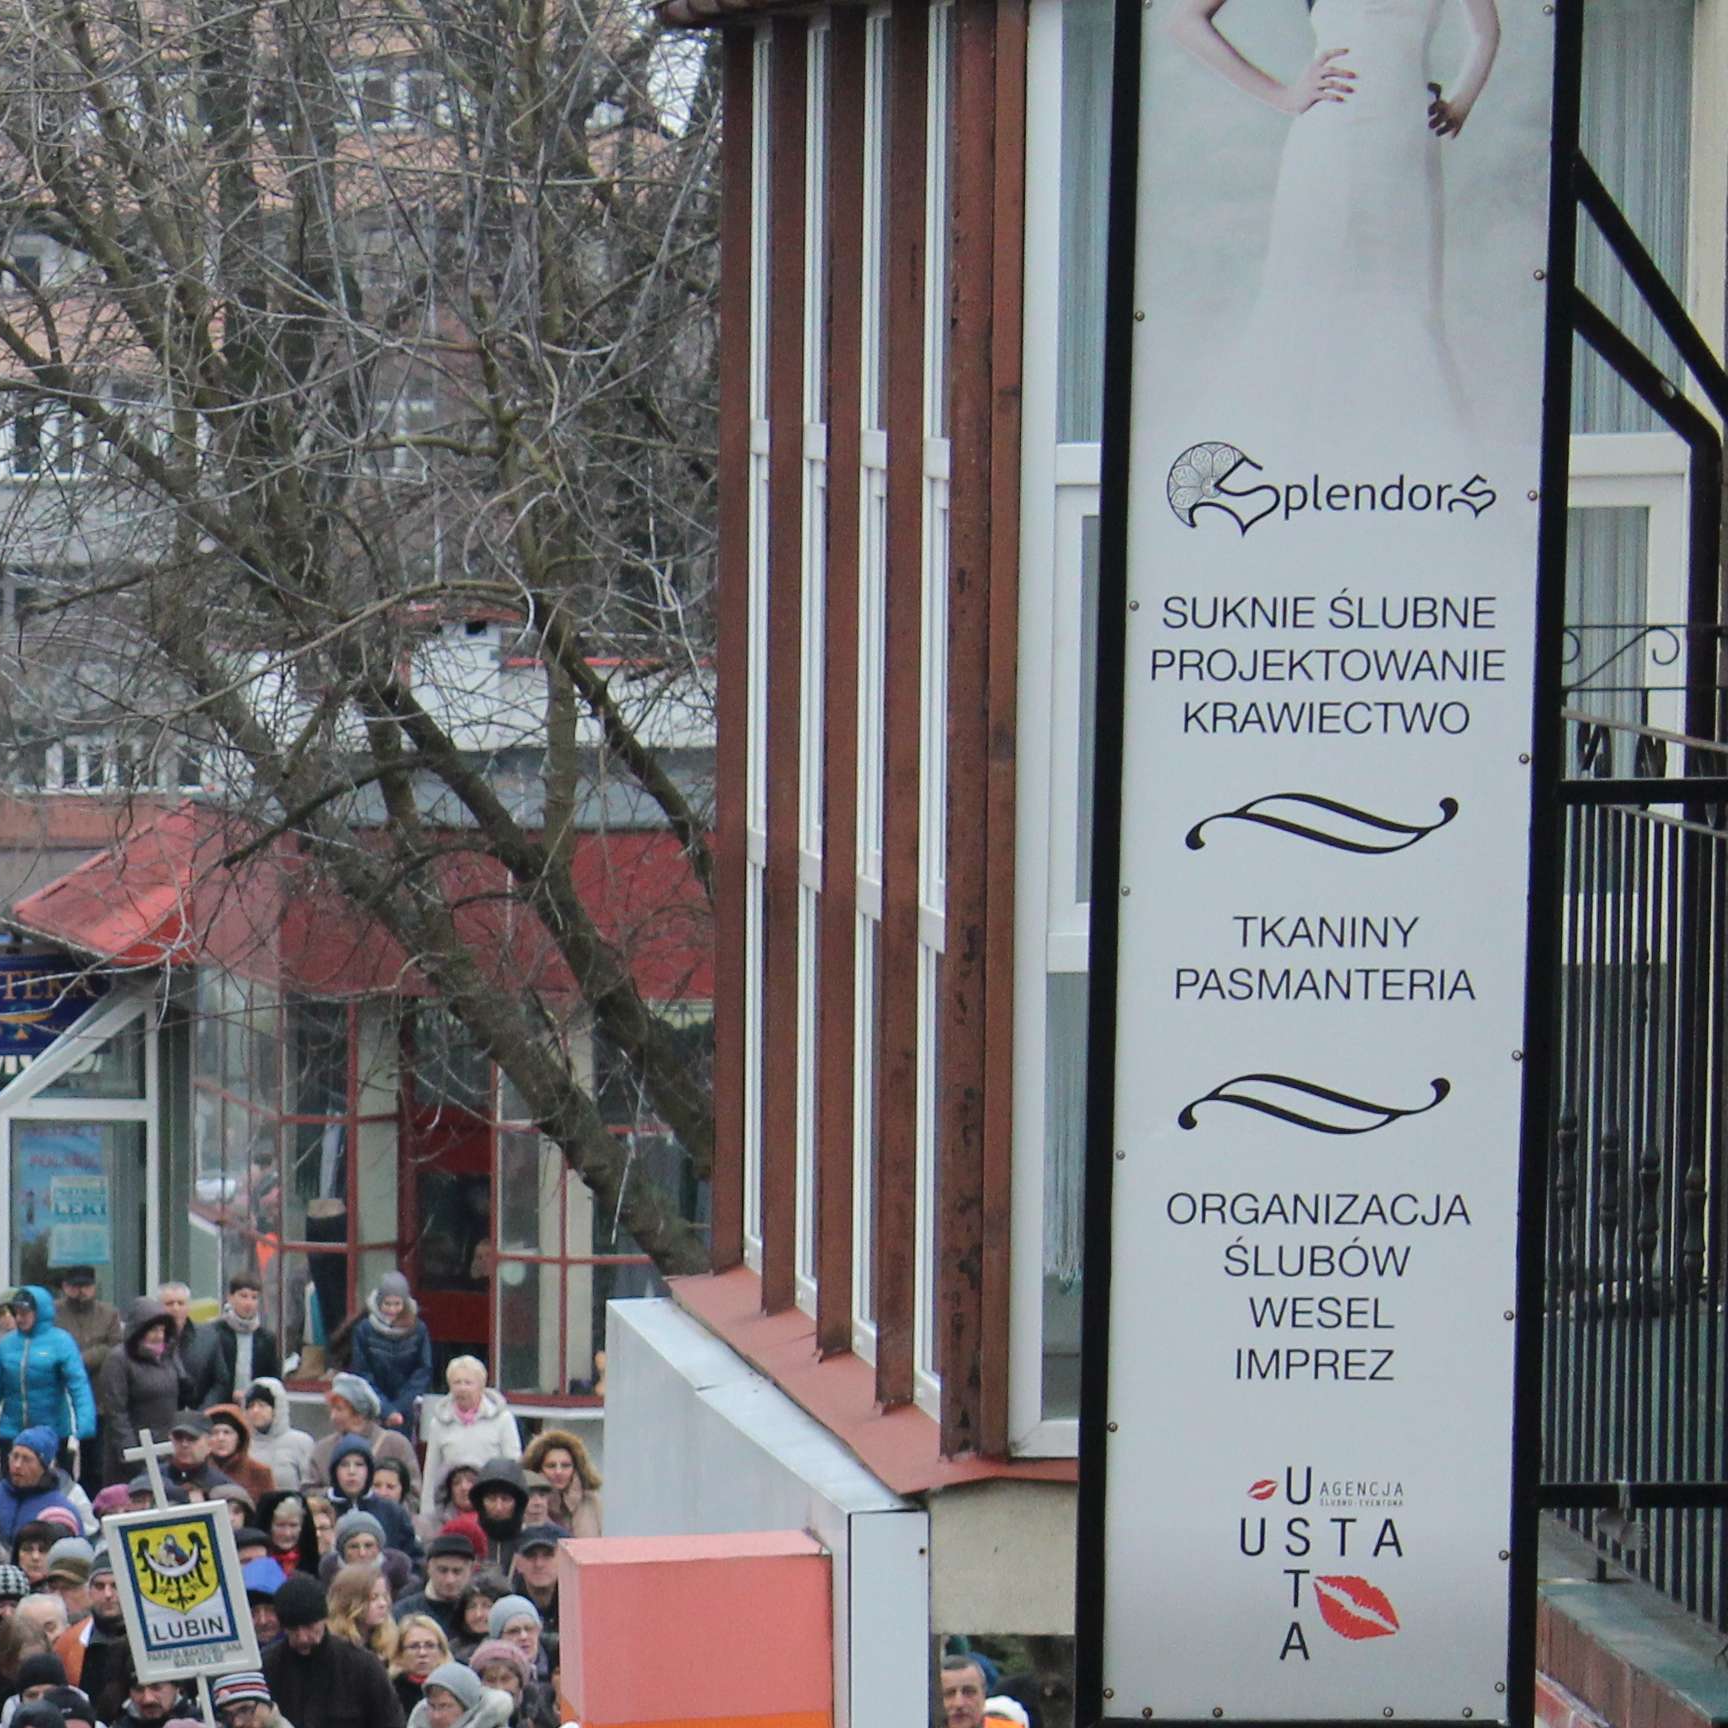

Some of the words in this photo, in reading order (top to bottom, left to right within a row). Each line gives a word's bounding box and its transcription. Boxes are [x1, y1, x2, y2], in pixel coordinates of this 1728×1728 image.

[1188, 455, 1496, 536] Splendors
[1163, 597, 1315, 628] SUKNIE
[1329, 588, 1496, 629] ŚLUBNE
[1152, 649, 1505, 681] PROJEKTOWANIE
[1184, 702, 1469, 734] KRAWIECTWO
[1234, 917, 1418, 947] TKANINY
[1176, 968, 1475, 1000] PASMANTERIA
[1167, 1193, 1470, 1225] ORGANIZACJA
[1225, 1237, 1410, 1277] ŚLUBÓW
[1250, 1297, 1394, 1328] WESEL
[1237, 1349, 1394, 1380] IMPREZ
[1319, 1481, 1404, 1497] AGENCJA
[1240, 1517, 1403, 1557] USTA
[153, 1616, 224, 1641] LUBIN
